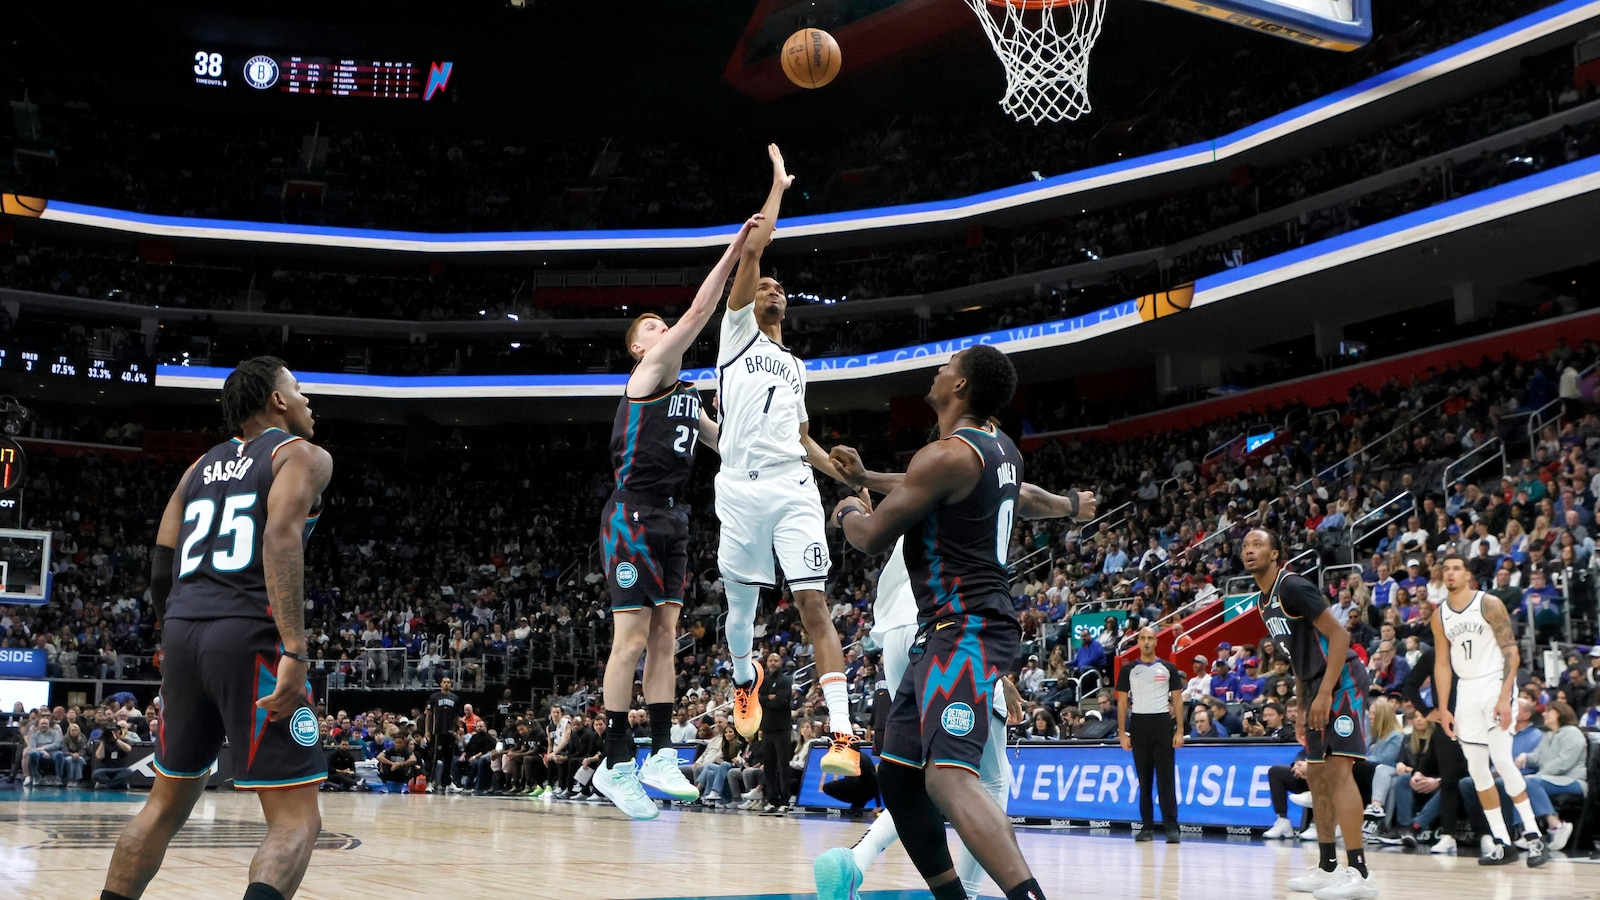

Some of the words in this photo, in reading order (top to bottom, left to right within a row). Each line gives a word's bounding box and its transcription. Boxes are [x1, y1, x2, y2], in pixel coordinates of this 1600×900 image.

[194, 51, 223, 77] 38
[257, 64, 265, 80] B
[26, 361, 32, 371] 3
[59, 356, 67, 364] FT
[93, 360, 105, 368] 3PT
[51, 363, 76, 376] 87.5%
[87, 367, 112, 380] 33.3%
[130, 363, 138, 372] FG
[121, 371, 148, 384] 40.6%
[745, 355, 800, 395] BROOKLYN
[763, 385, 777, 414] 1
[667, 394, 701, 420] DETR
[203, 456, 254, 486] SASER
[178, 490, 258, 579] 25
[995, 497, 1015, 567] 0
[813, 546, 823, 567] B
[1446, 621, 1485, 642] BROOKLYN
[0, 650, 33, 663] SIDE
[1461, 639, 1472, 661] 17
[948, 707, 971, 720] DETROIT
[946, 716, 969, 728] PISTONS
[1032, 764, 1141, 803] EVERY
[1089, 820, 1110, 828] StockX
[1179, 824, 1203, 833] StockX
[1226, 826, 1252, 835] StockX
